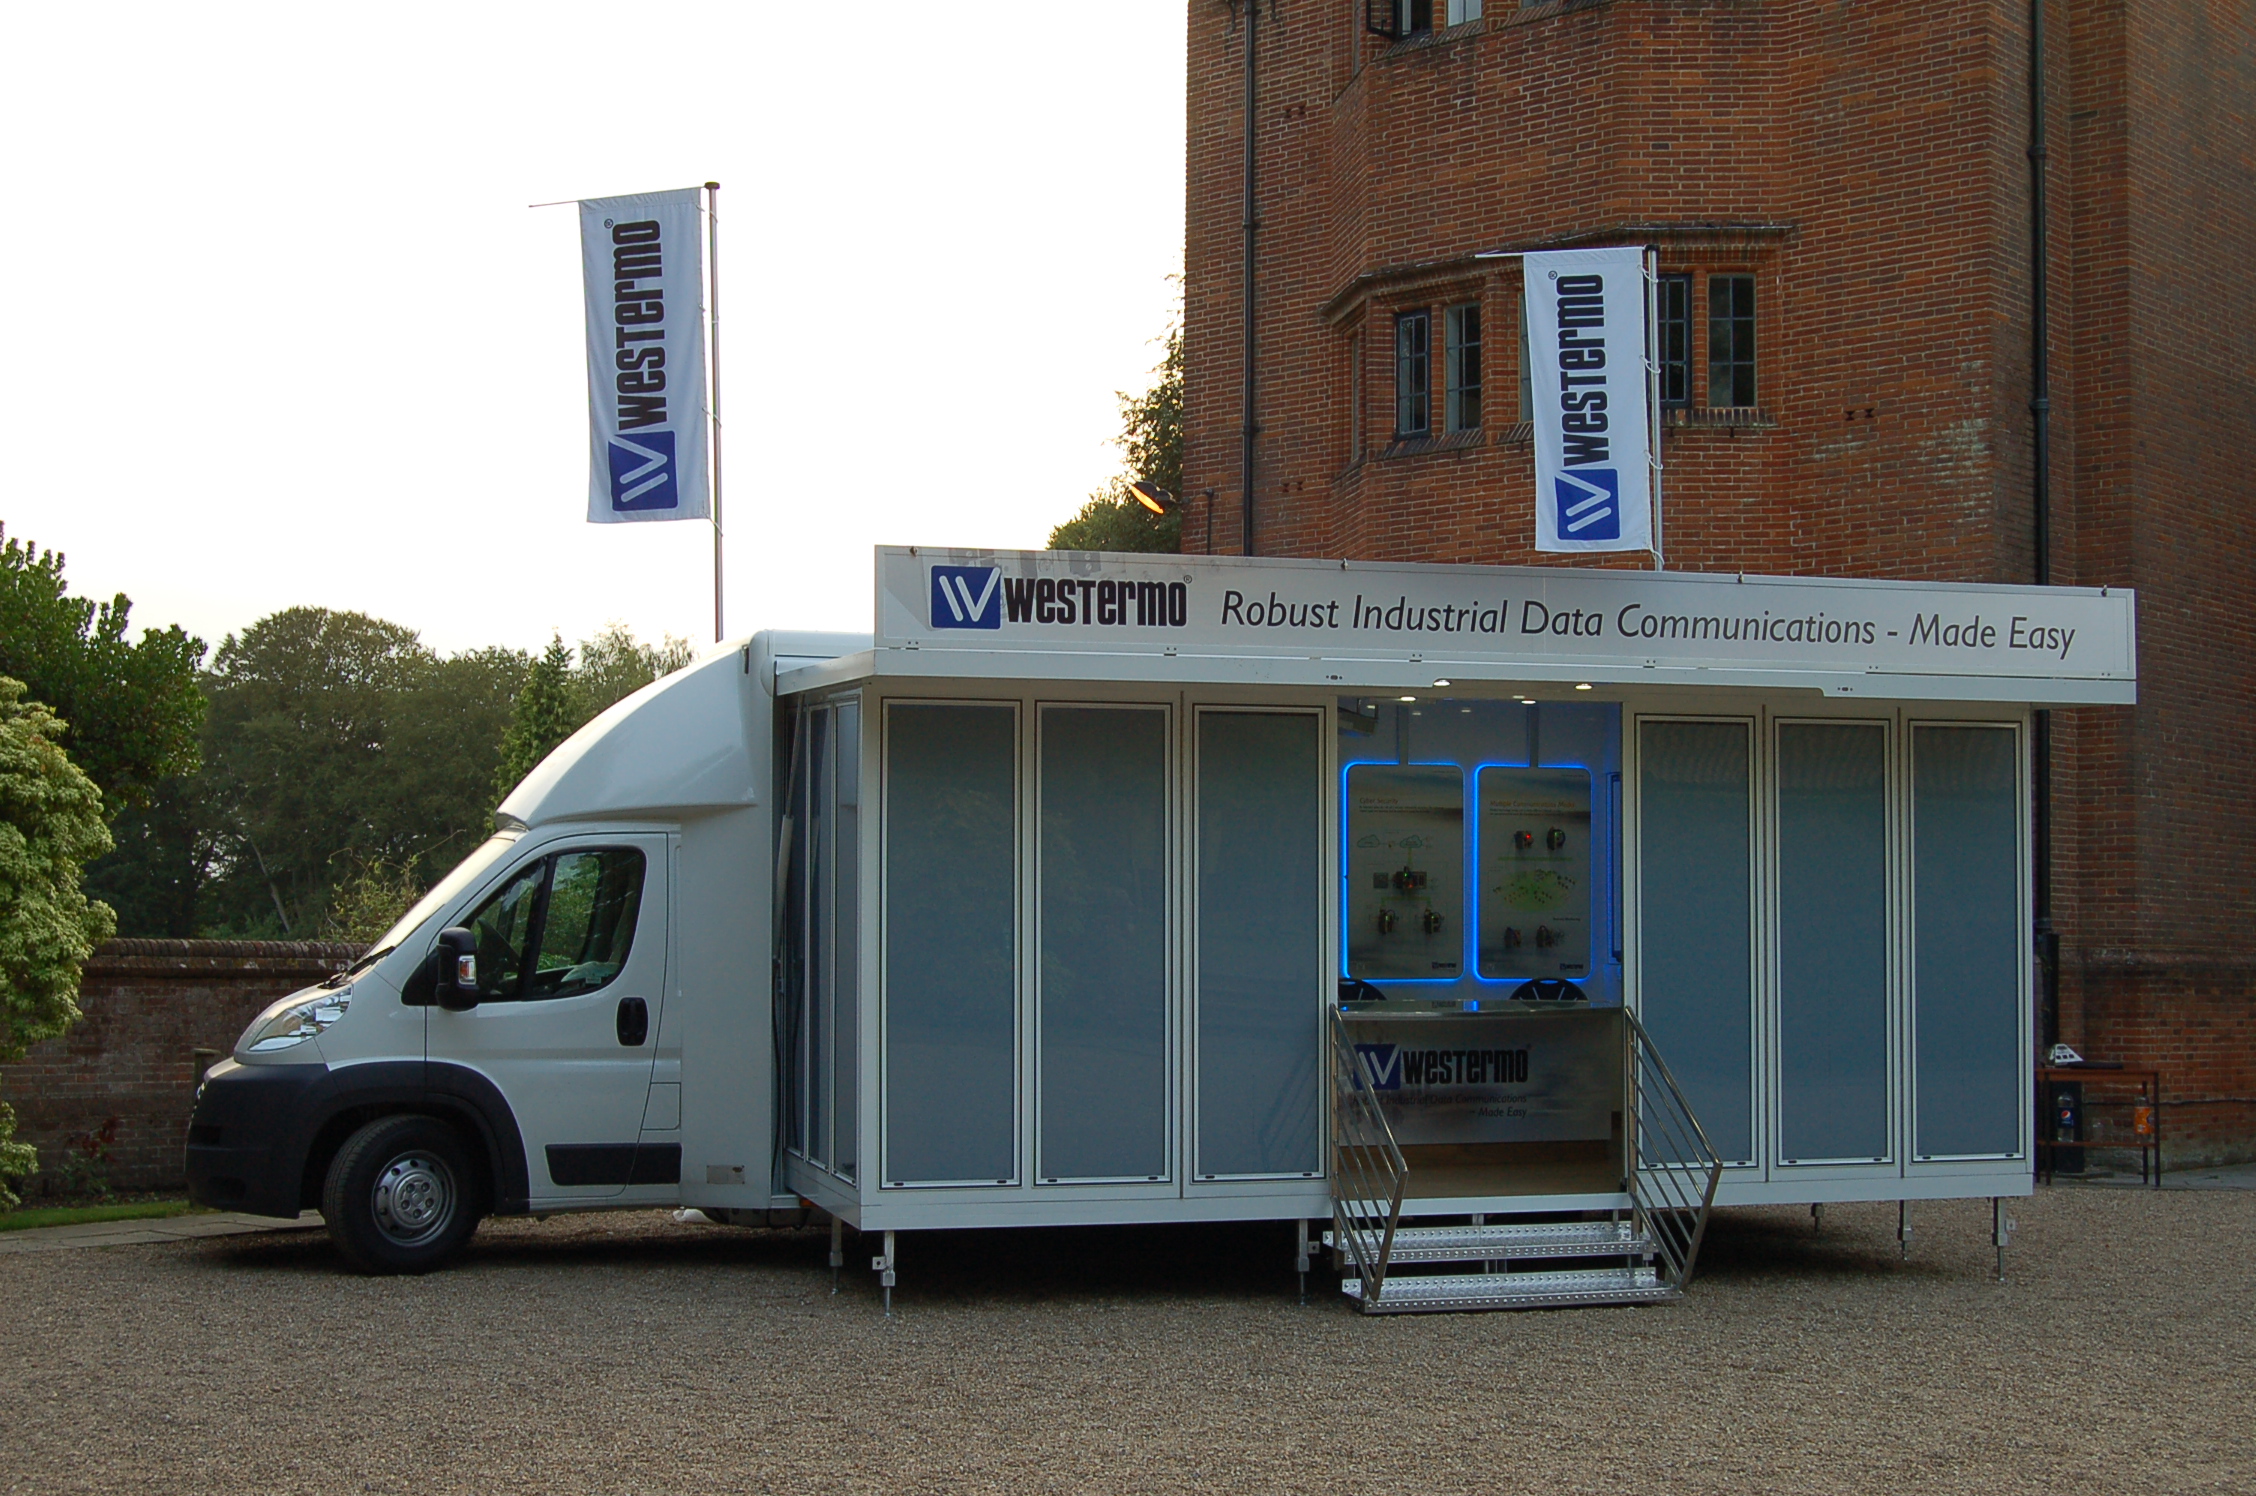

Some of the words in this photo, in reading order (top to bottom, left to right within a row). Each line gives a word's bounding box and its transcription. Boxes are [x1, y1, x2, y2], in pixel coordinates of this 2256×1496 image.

[1220, 590, 1340, 629] Robust
[1352, 594, 1508, 634] Industrial
[1520, 600, 1603, 637] Data
[1616, 603, 1876, 645] Communications
[1908, 613, 1997, 648] Made
[2008, 617, 2077, 660] Easy
[1478, 1107, 1504, 1117] Made
[1507, 1106, 1527, 1119] Easy
